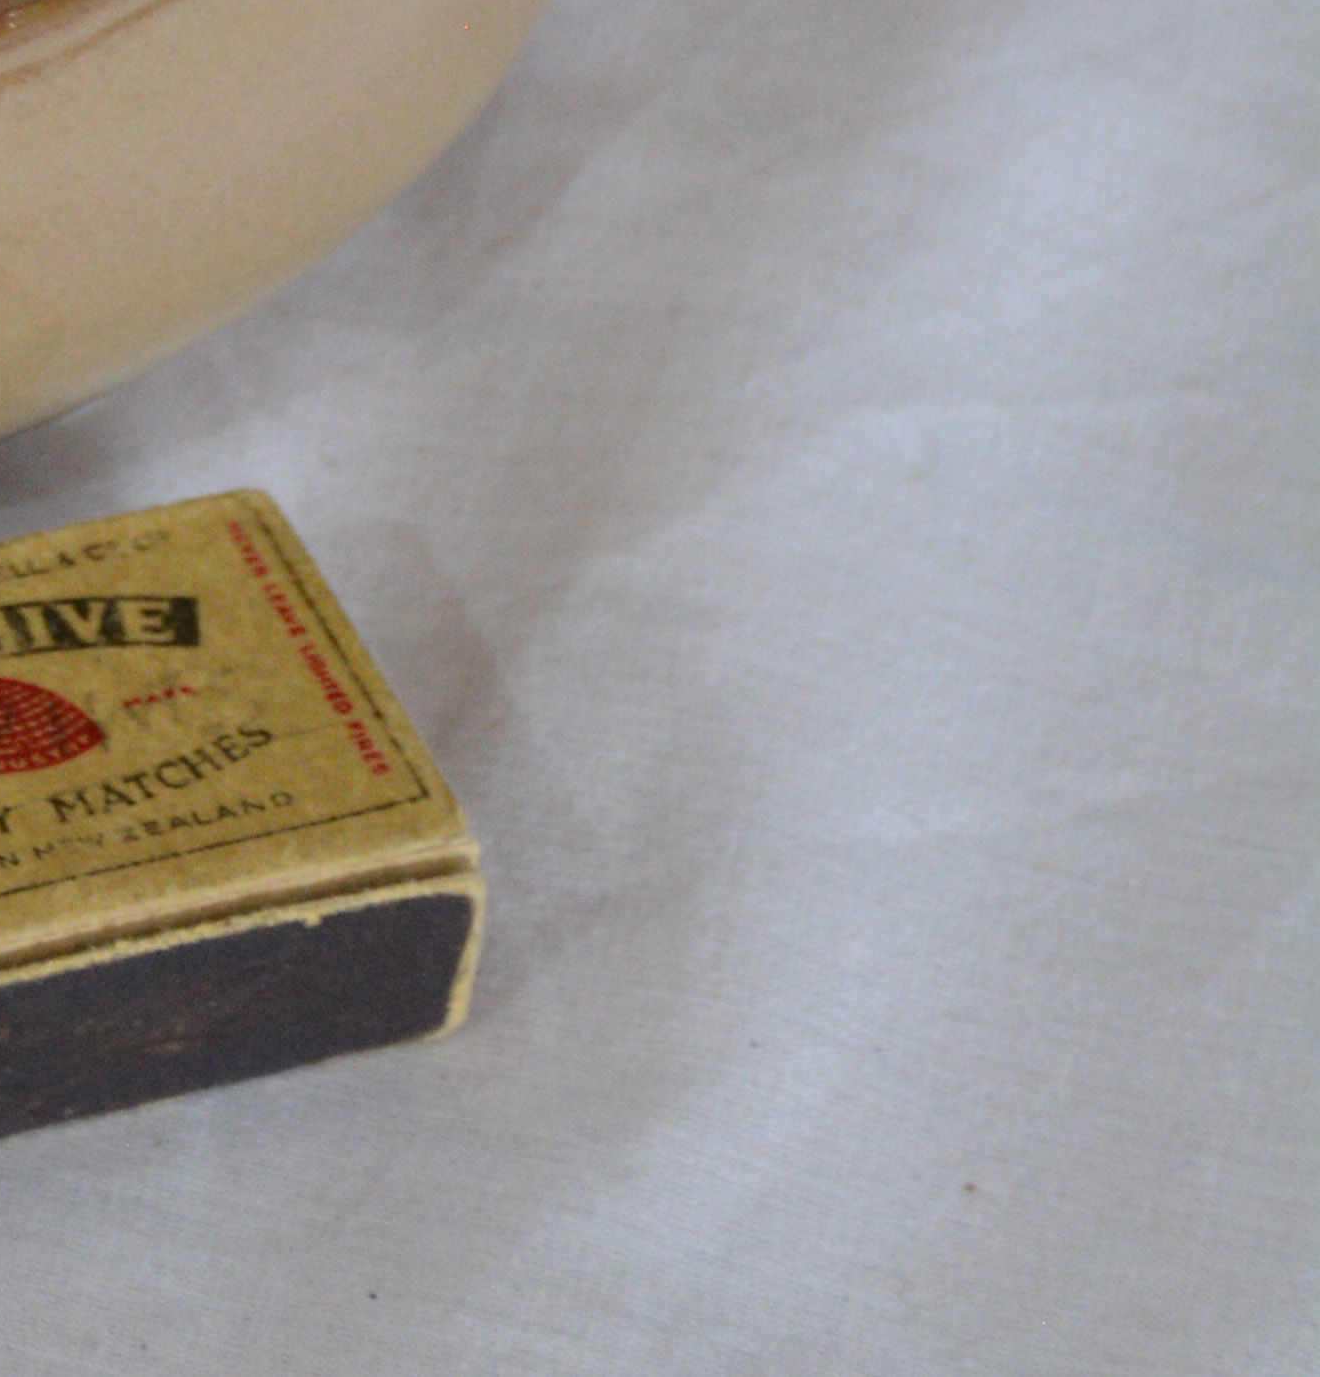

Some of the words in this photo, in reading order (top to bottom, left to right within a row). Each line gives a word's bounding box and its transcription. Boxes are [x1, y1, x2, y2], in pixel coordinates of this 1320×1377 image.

[262, 582, 307, 637] LEAVE
[298, 643, 355, 715] LIGHTED
[346, 719, 392, 777] FIRES
[47, 726, 273, 824] MATCHES
[121, 790, 294, 843] ZEALAND
